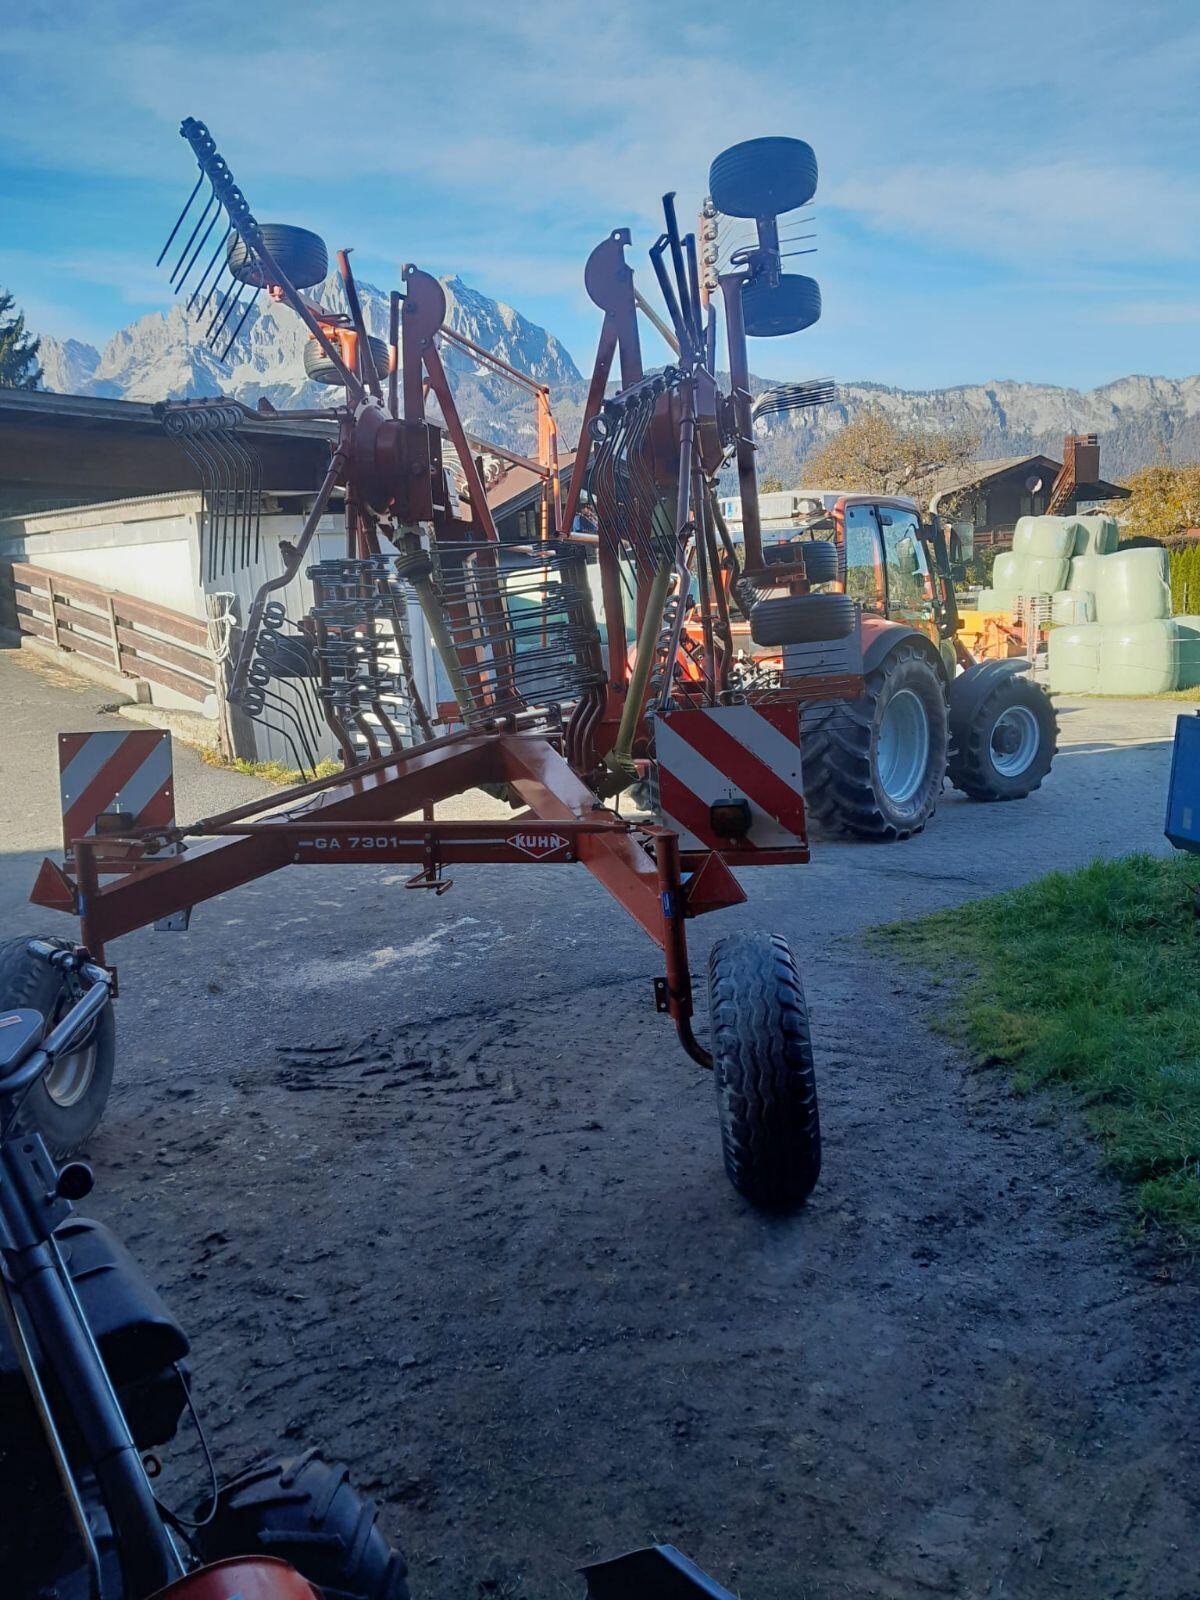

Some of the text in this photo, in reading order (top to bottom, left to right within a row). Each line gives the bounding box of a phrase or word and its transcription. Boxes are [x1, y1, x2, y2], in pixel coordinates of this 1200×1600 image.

[314, 836, 398, 849] GA 7301
[515, 834, 561, 849] KUHN
